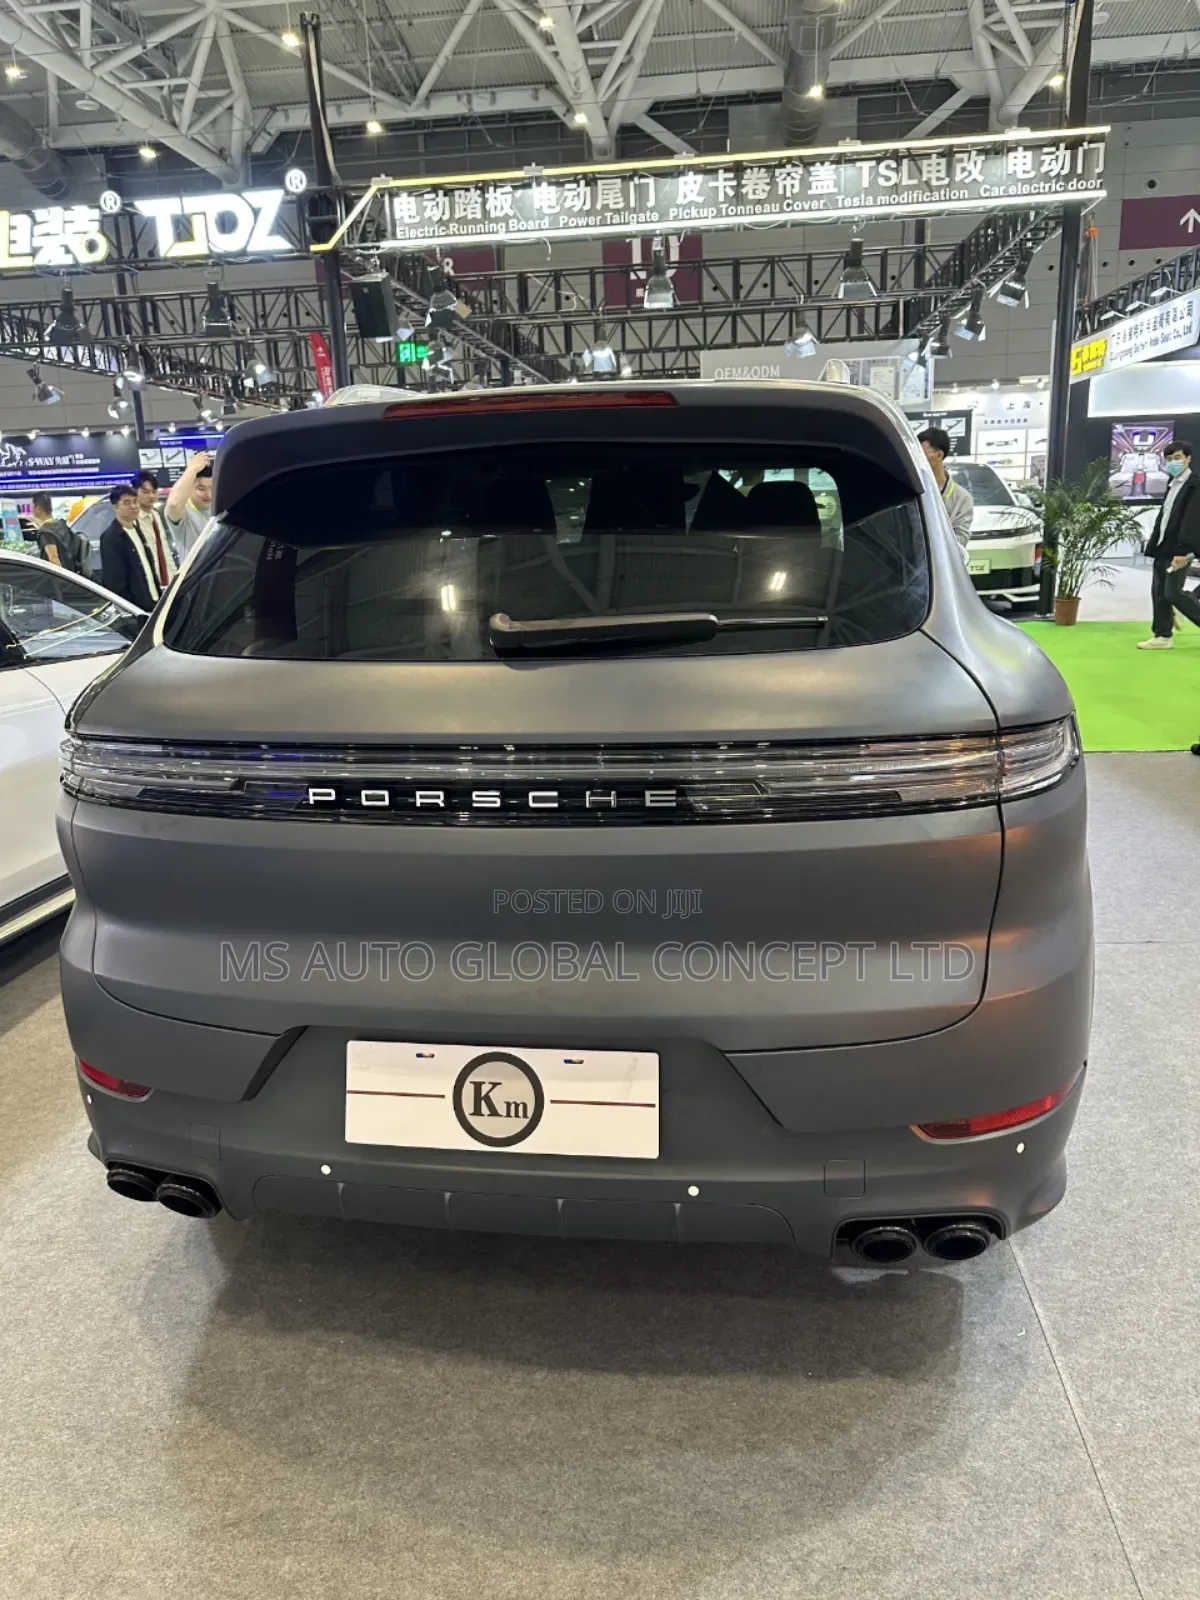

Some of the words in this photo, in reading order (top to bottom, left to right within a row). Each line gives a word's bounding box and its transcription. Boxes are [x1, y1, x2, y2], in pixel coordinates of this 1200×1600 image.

[393, 185, 515, 224] 电动踏板
[533, 175, 656, 214] 电动尾门
[676, 161, 838, 205] 皮卡卷帘盖
[1008, 141, 1105, 180] 电动门
[396, 225, 447, 240] Electric
[449, 220, 506, 235] Running
[509, 217, 550, 231] Board
[560, 215, 602, 228] Power
[604, 210, 659, 225] Tailgate
[669, 205, 717, 219] Pickup
[719, 202, 779, 216] Tonneau
[783, 199, 826, 211] Cover
[836, 193, 877, 208] Tesla
[877, 188, 968, 206] modification
[980, 184, 1006, 197] Car
[1008, 179, 1065, 194] electric
[1068, 178, 1104, 191] door
[308, 788, 677, 808] PORSCHE
[469, 1080, 530, 1119] Km
